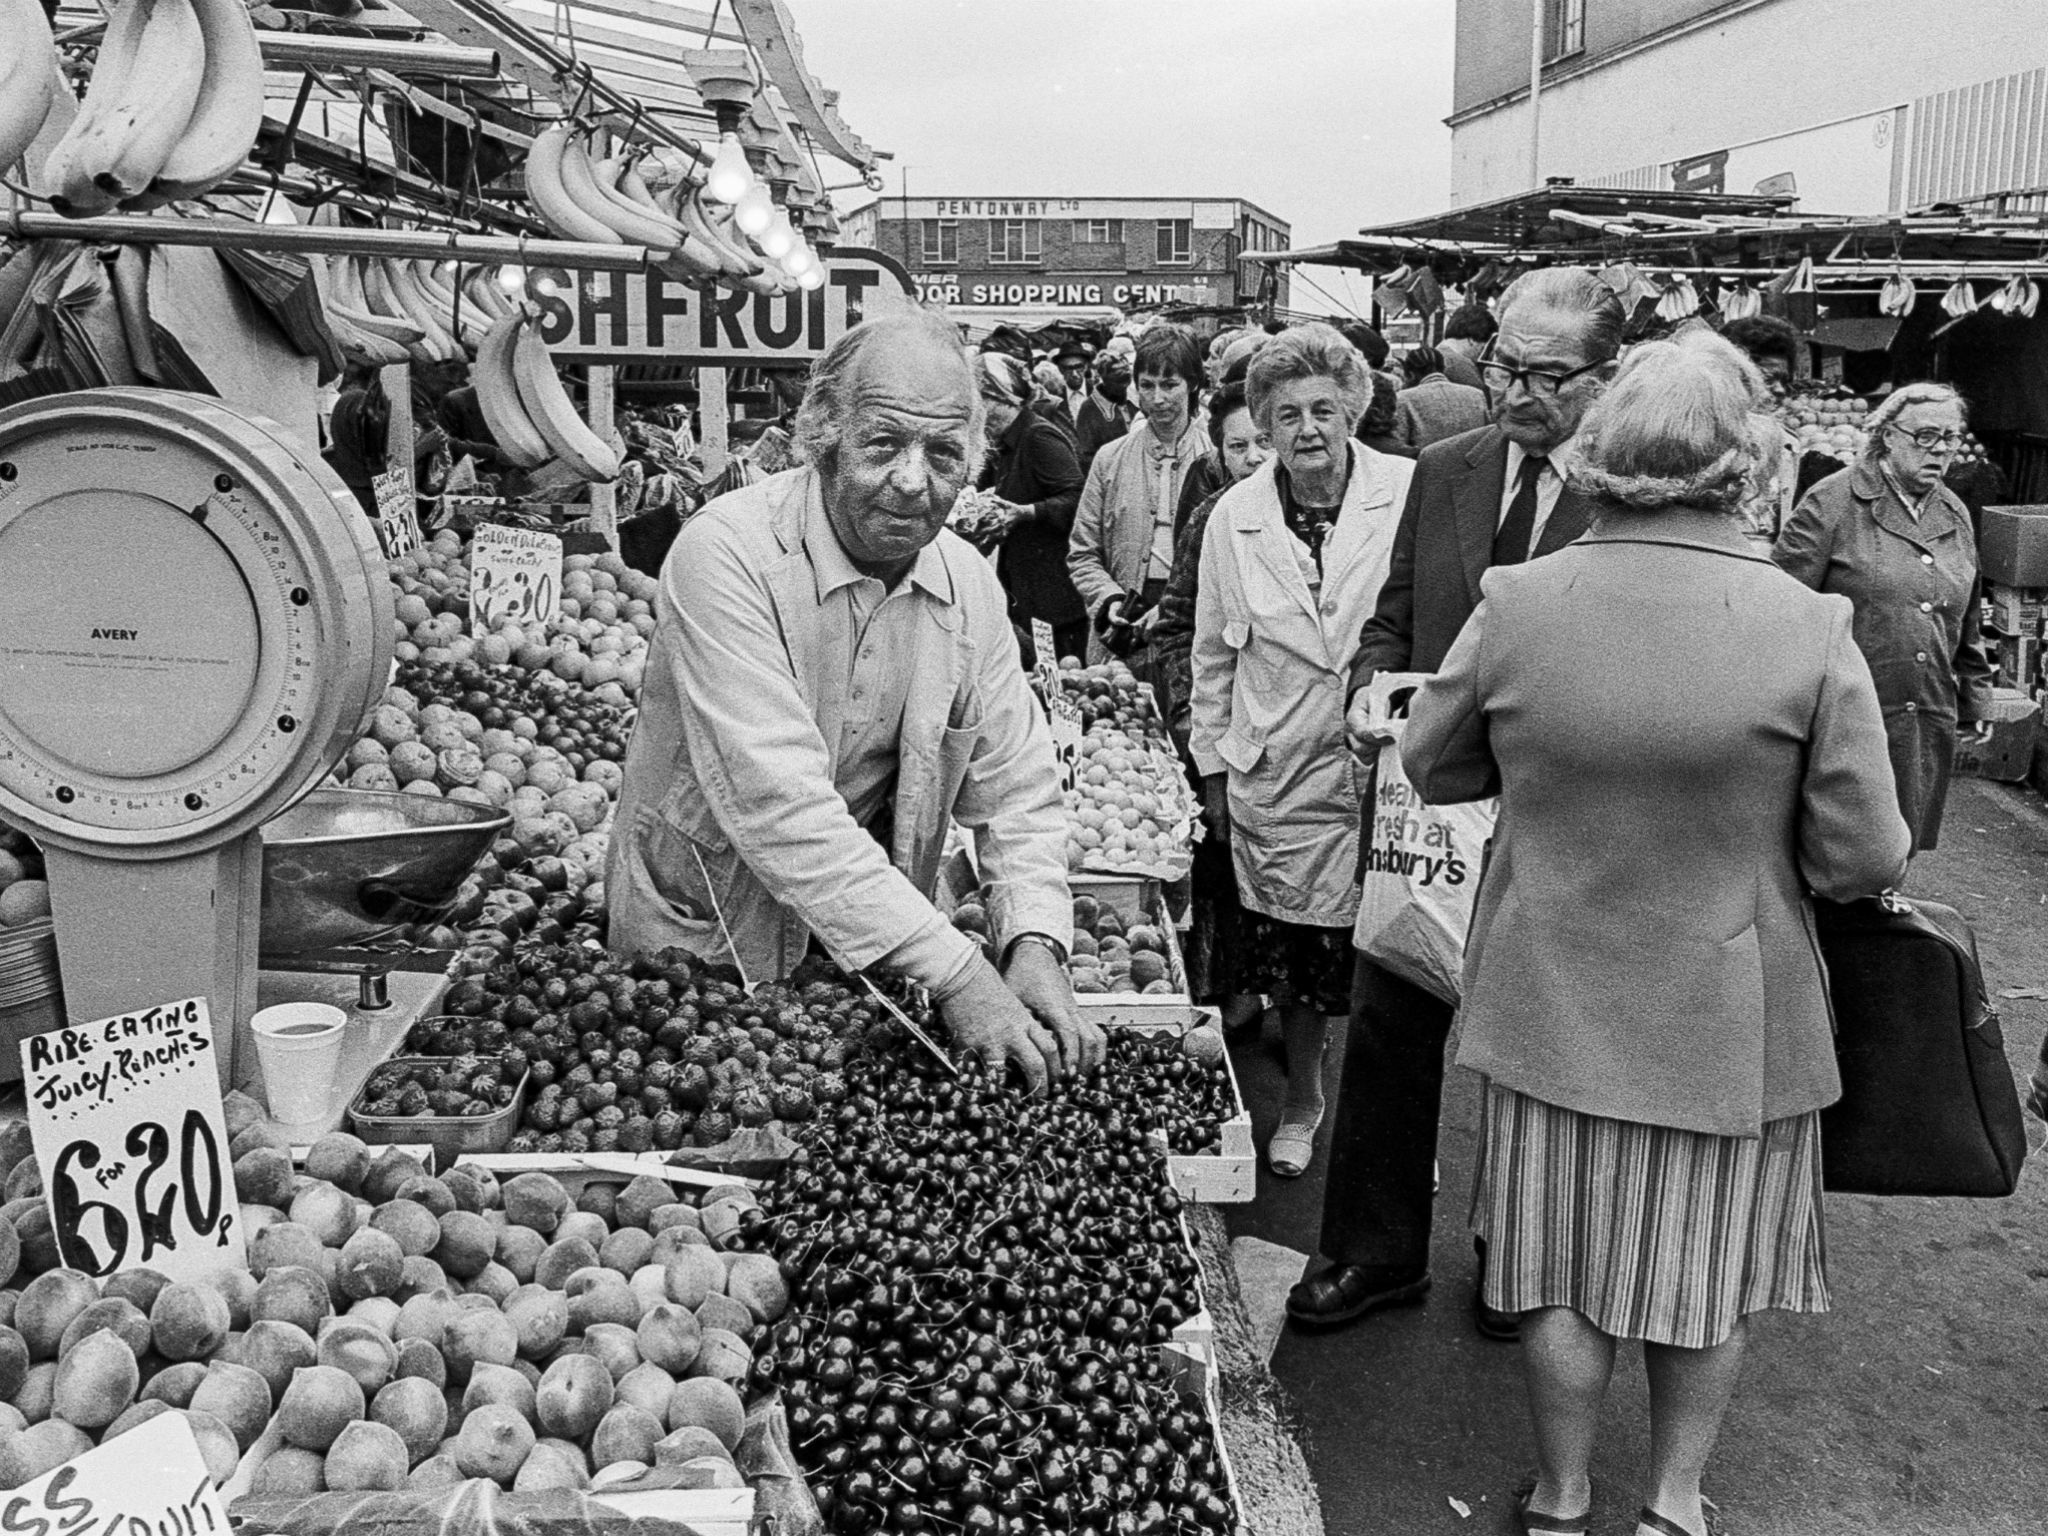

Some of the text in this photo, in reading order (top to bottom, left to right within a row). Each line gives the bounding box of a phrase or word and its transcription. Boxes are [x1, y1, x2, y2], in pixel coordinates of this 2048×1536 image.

[645, 267, 880, 350] FRUIT
[972, 284, 1101, 304] SHOPPING
[1113, 284, 1205, 304] CENT
[91, 628, 138, 640] AVERY
[1423, 820, 1456, 850] at
[30, 1001, 199, 1073] RIPE EATING
[52, 1139, 129, 1279] 6
